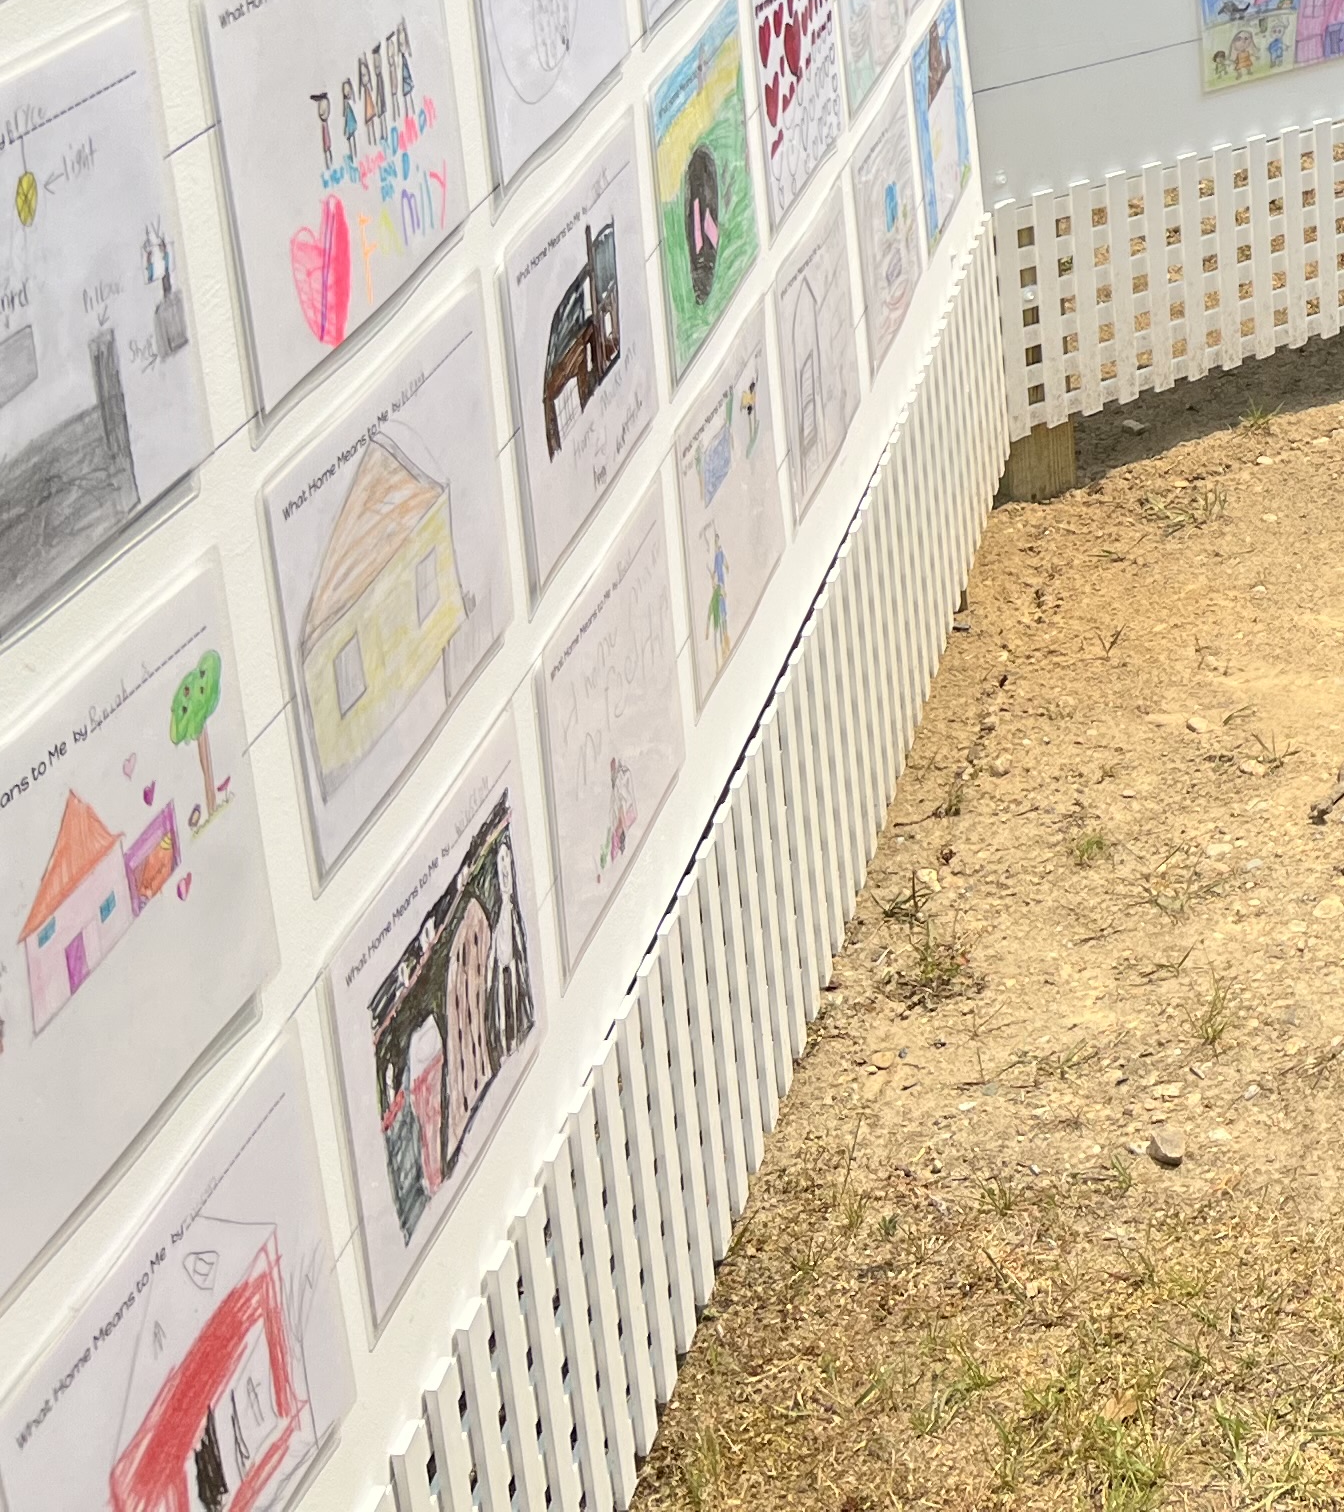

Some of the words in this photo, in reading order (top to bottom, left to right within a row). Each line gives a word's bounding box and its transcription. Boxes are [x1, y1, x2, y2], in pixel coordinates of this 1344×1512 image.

[218, 3, 246, 29] What
[530, 247, 547, 270] Home
[547, 227, 567, 252] Means
[281, 493, 308, 523] What
[308, 463, 337, 497] Home
[337, 434, 368, 470] Means
[367, 423, 377, 440] to
[377, 410, 390, 429] Me
[391, 402, 402, 414] by
[31, 761, 47, 782] to
[48, 742, 67, 767] Me
[73, 725, 88, 743] by
[345, 958, 367, 988] What
[367, 922, 392, 958] Home
[392, 888, 419, 925] Means
[419, 873, 428, 890] to
[427, 857, 439, 878] Me
[441, 843, 450, 858] by
[16, 1396, 53, 1451] What
[51, 1347, 92, 1402] Home
[93, 1291, 136, 1350] Means
[135, 1272, 150, 1295] to
[150, 1247, 167, 1274] Me
[170, 1227, 186, 1245] by
